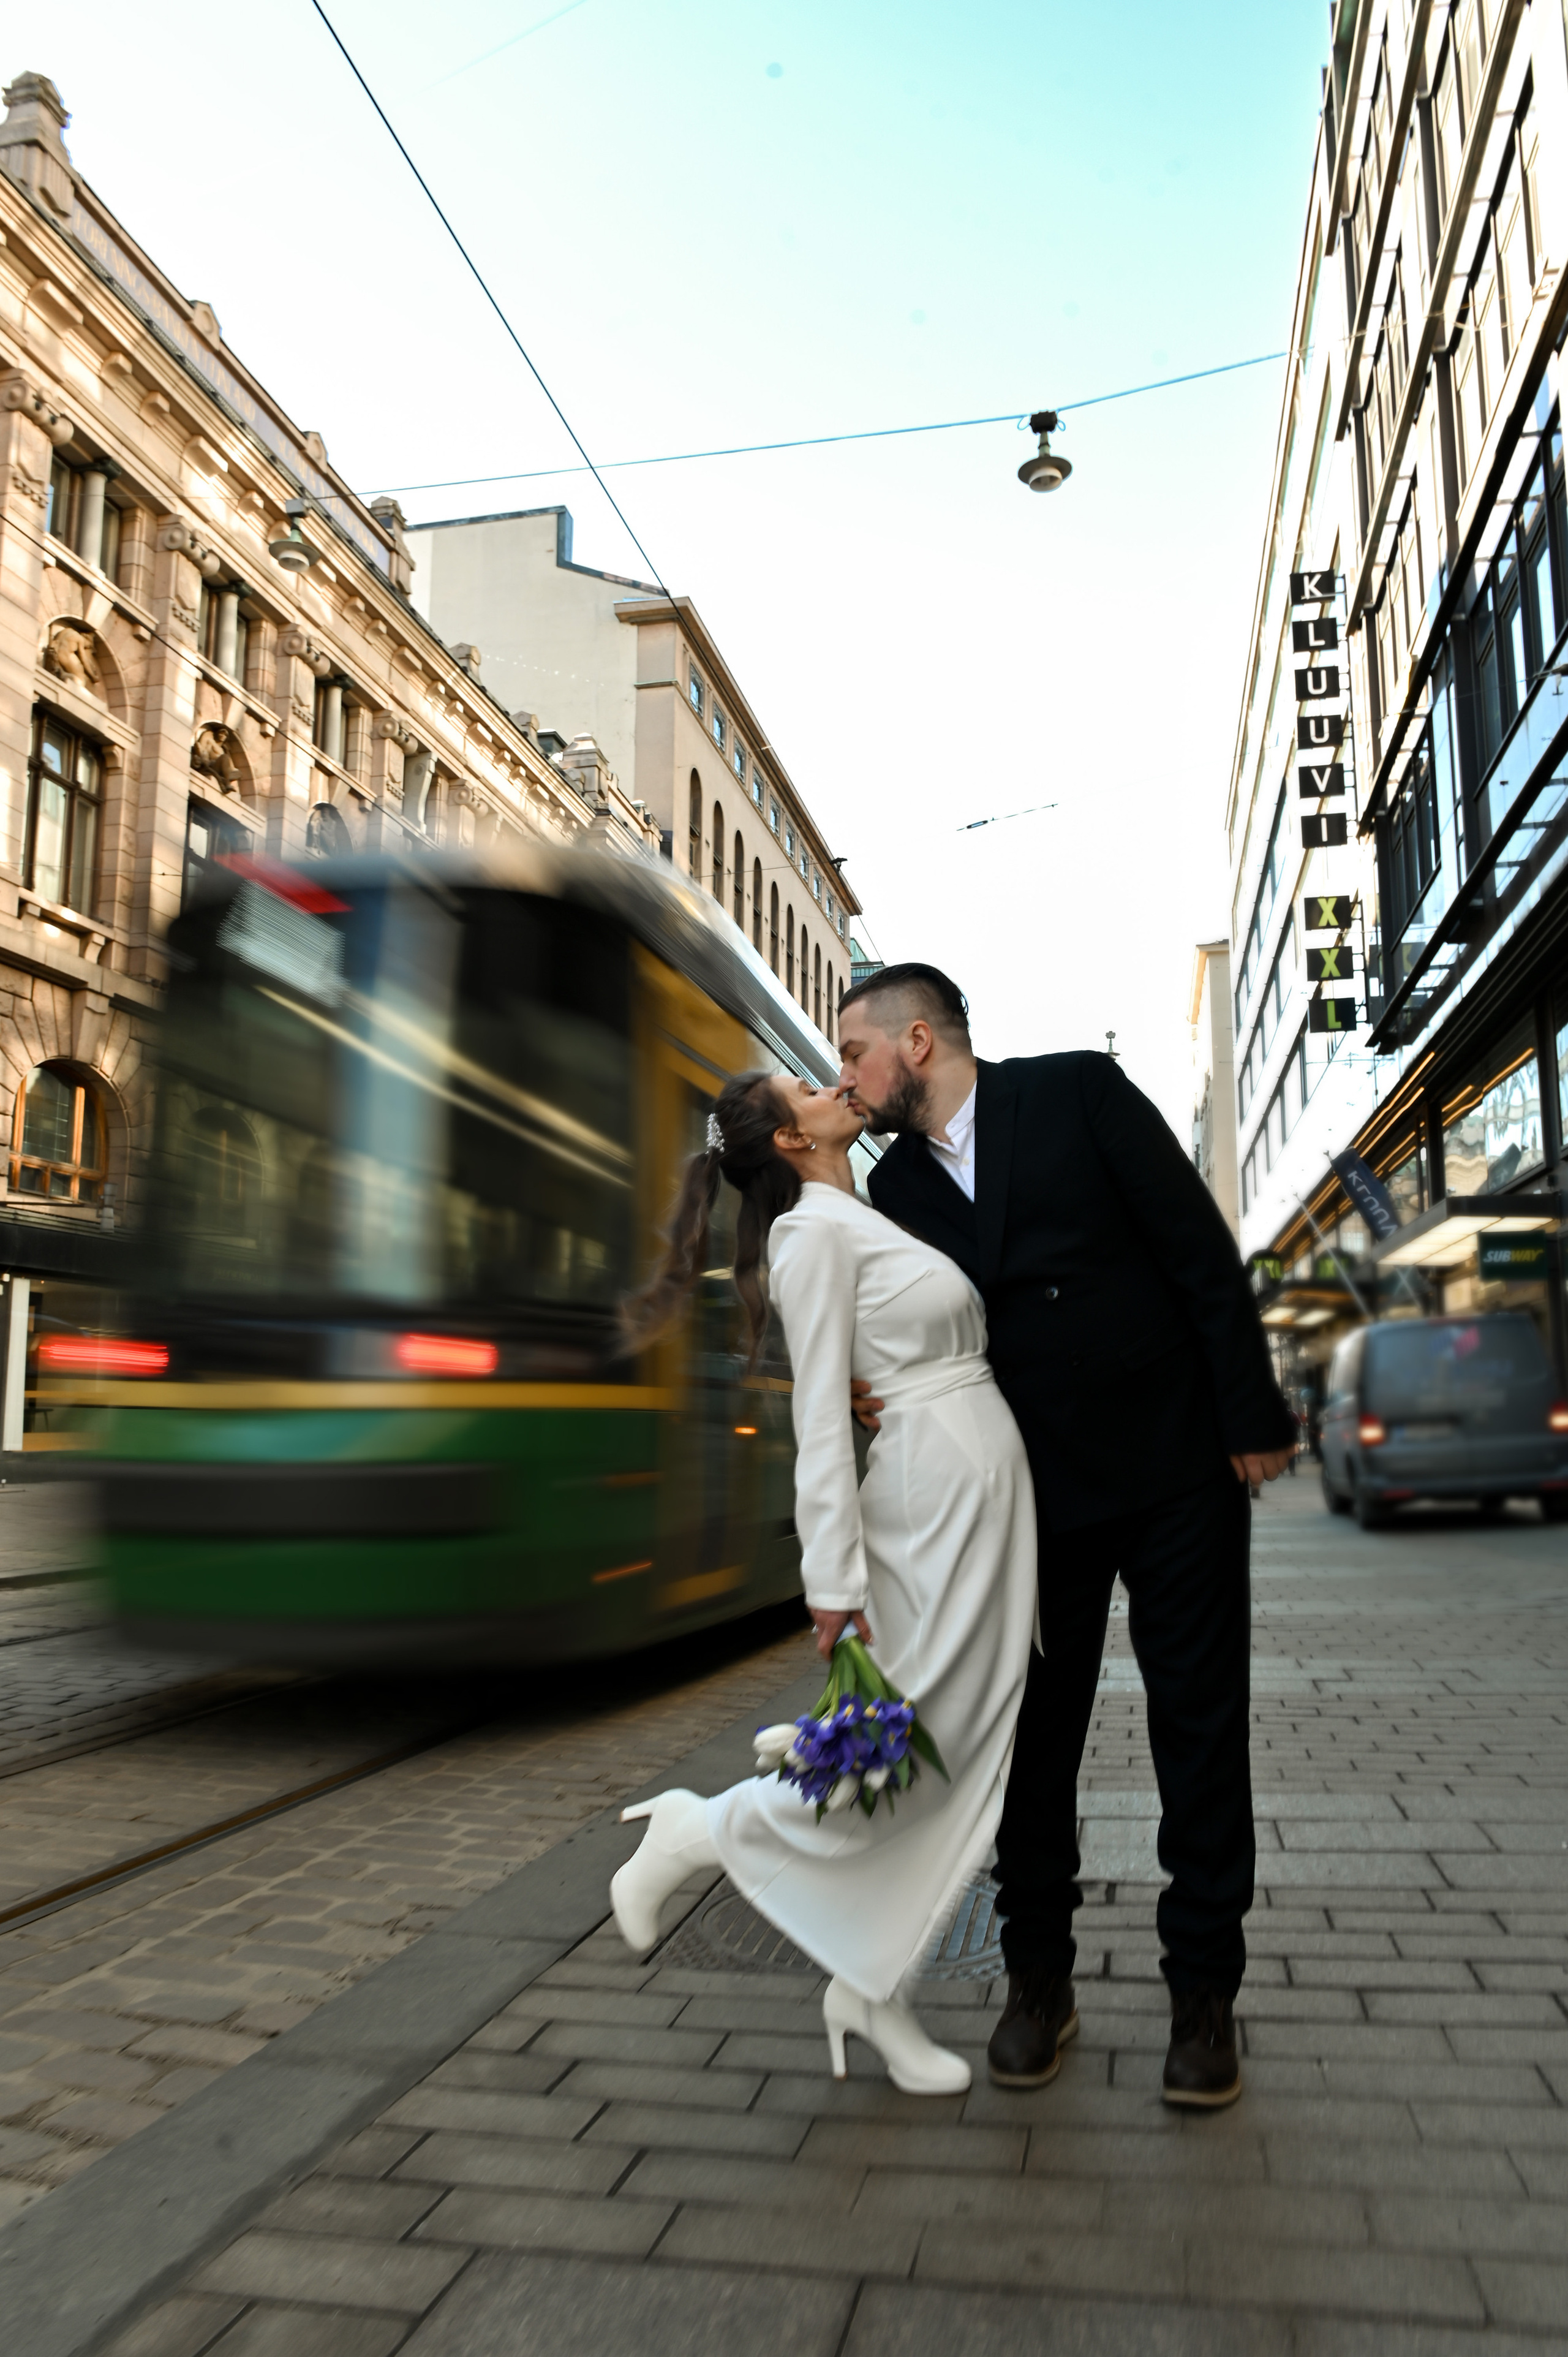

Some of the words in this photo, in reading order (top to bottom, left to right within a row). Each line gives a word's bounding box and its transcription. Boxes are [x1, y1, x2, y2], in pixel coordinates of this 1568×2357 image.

[1303, 573, 1332, 842] KLUUVI
[1317, 897, 1342, 1029] XXL
[1483, 1250, 1544, 1262] SUBWAY
